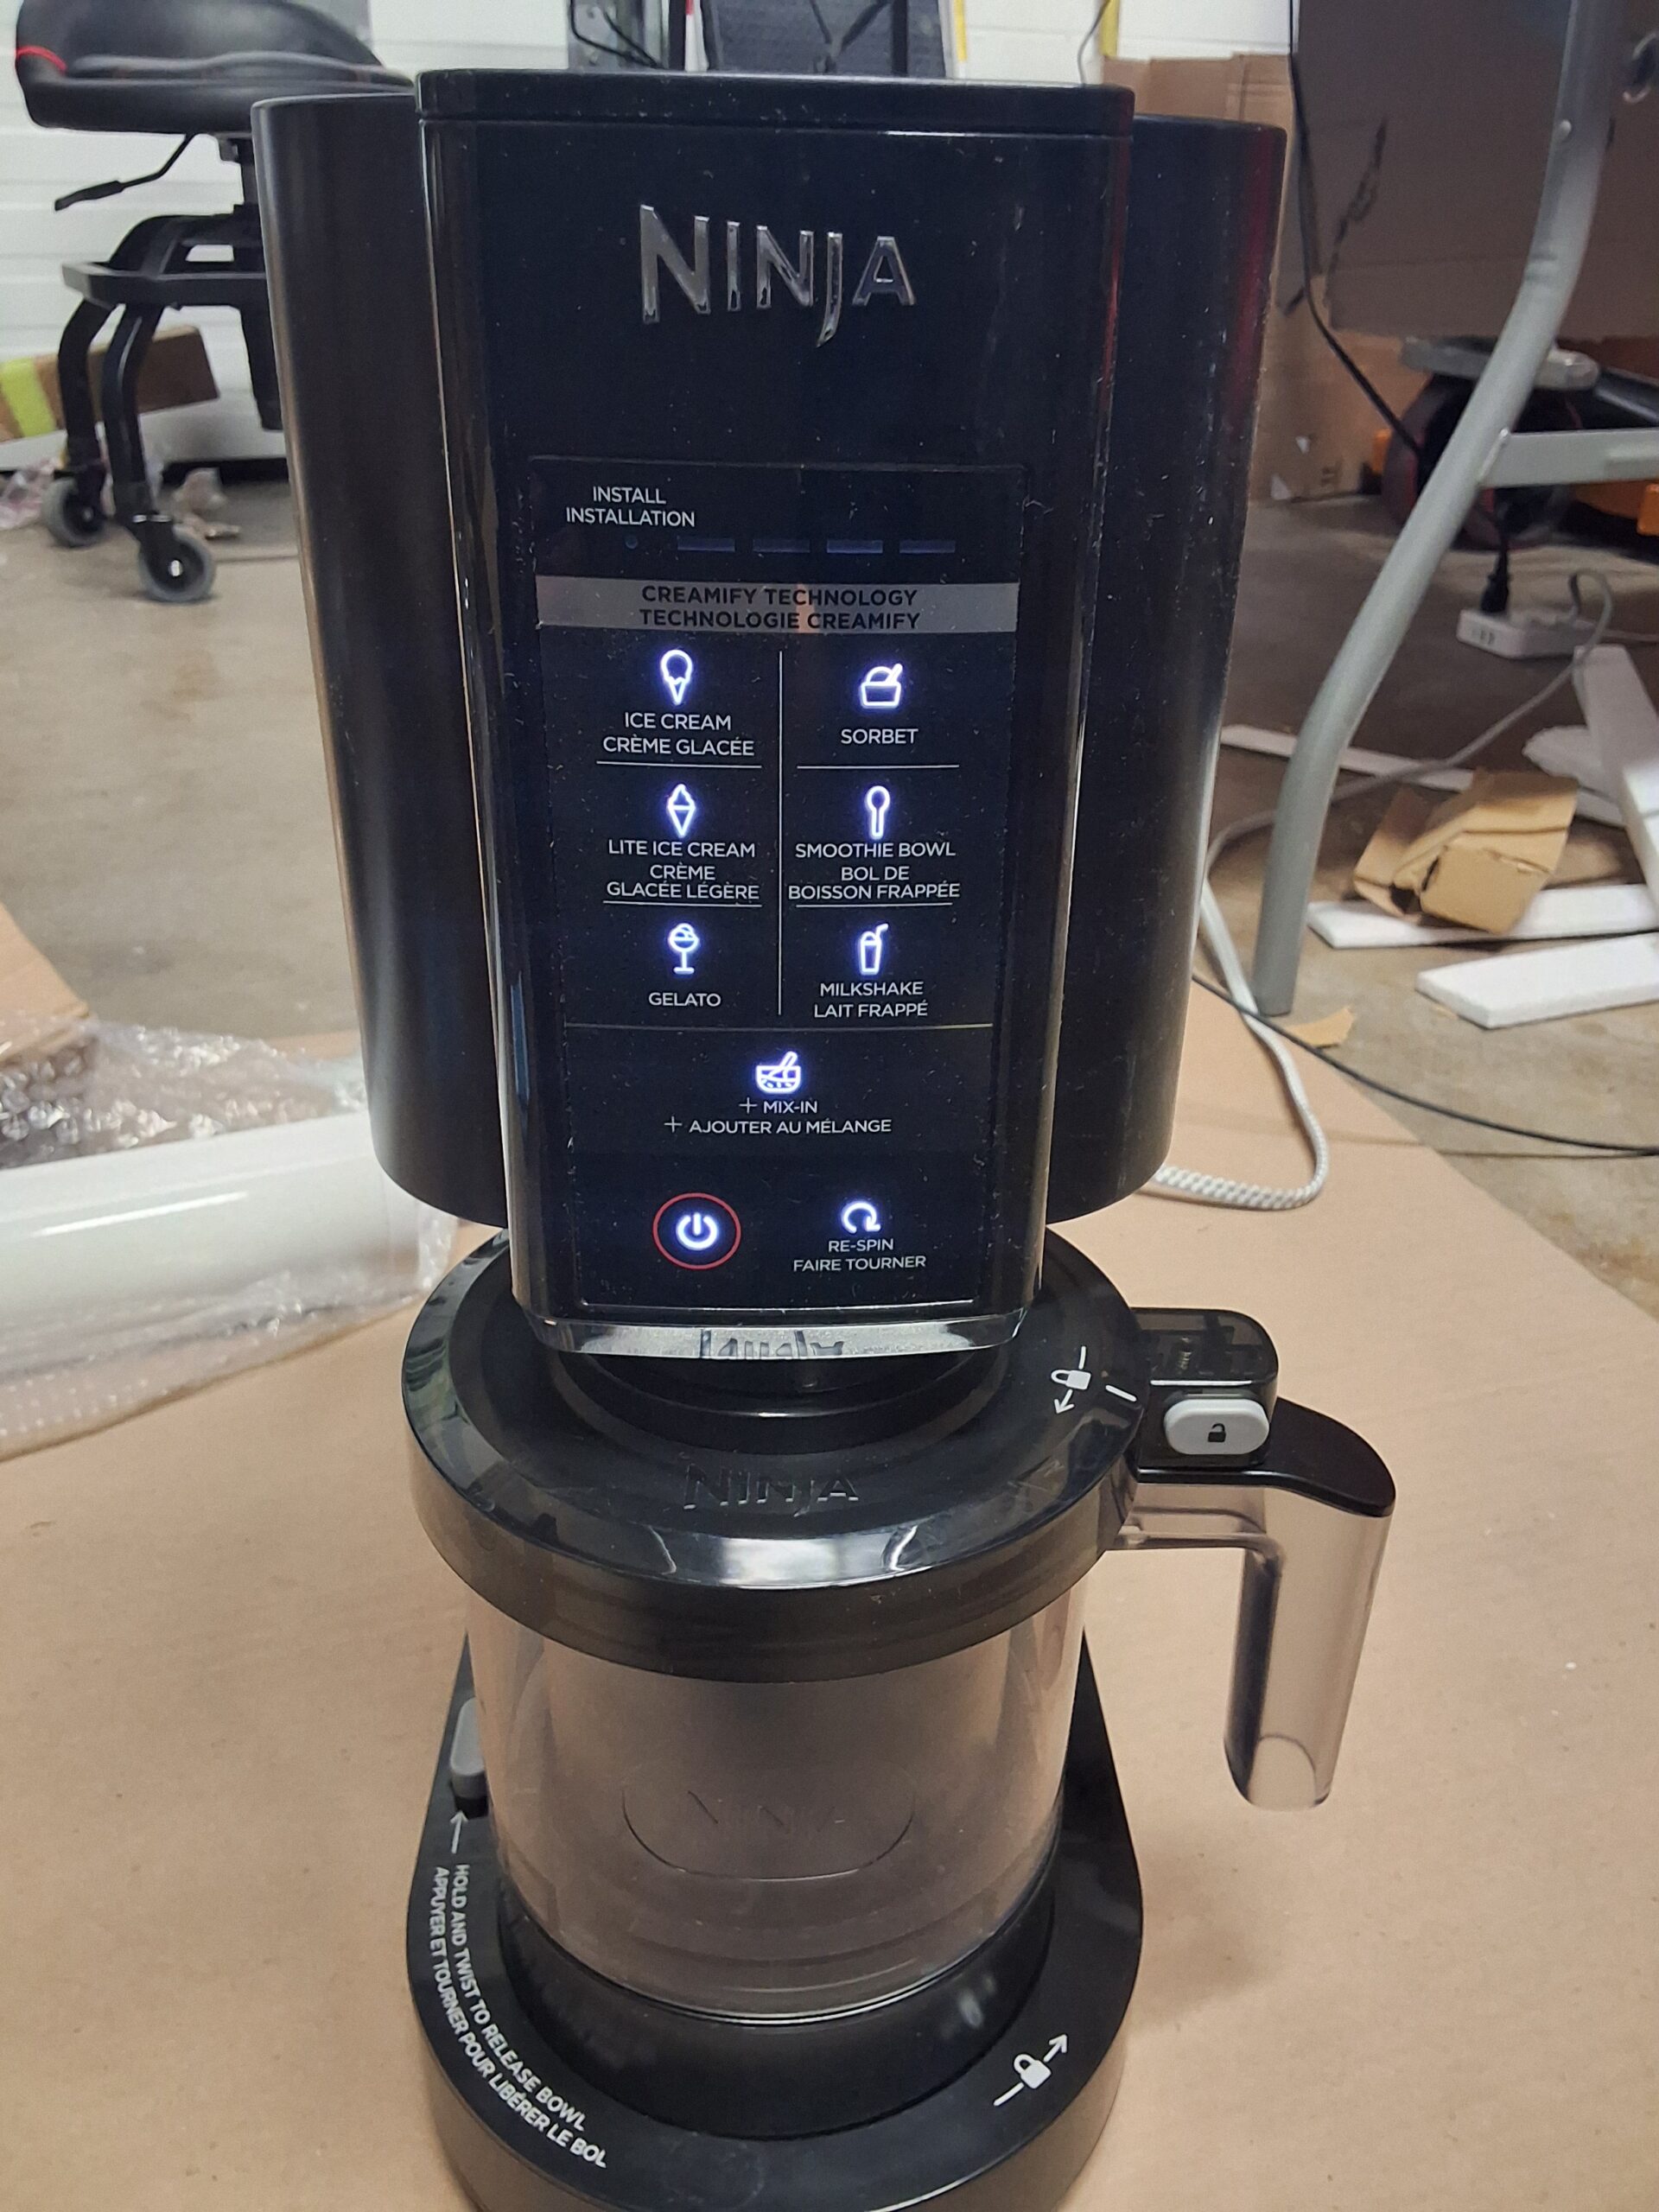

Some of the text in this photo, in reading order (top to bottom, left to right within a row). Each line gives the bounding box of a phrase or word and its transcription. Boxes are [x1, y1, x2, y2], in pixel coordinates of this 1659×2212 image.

[640, 204, 916, 347] NINJA
[593, 486, 666, 505] INSTALL
[566, 507, 696, 527] INSTALLATION
[641, 586, 918, 607] CREAMIFY TECHNOLOGY
[639, 608, 920, 630] TECHNOLOGIE CREAMIFY
[624, 712, 731, 730] ICE CREAM
[603, 733, 754, 756] CRÈME GLACÉE
[841, 728, 919, 745] SORBET
[608, 840, 755, 858] LITE ICE CREAM
[795, 842, 957, 859] SMOOTHIE BOWL
[650, 861, 715, 880] CRÈME
[841, 866, 910, 881] BOL DE
[607, 878, 760, 900] GLACÉE LÉGÈRE
[788, 880, 960, 900] BOISSON FRAPPÉE
[820, 981, 924, 998] MILKSHAKE
[648, 992, 721, 1007] GELATO
[814, 999, 928, 1019] LAIT FRAPPÉ
[763, 1100, 818, 1115] MIX-IN
[689, 1120, 772, 1135] AJOUTER
[776, 1120, 804, 1135] AU
[807, 1117, 892, 1135] MÉLANGE
[828, 1238, 894, 1253] RE-SPIN
[793, 1255, 926, 1272] FAIRE TOURNER
[683, 1463, 859, 1517] NINJA
[450, 1864, 587, 2132] HOLD AND TWIST TO RELEASE BOWL
[429, 1866, 607, 2168] APPUYER ET TOURNER POUR LIBÉRER LE BOL
